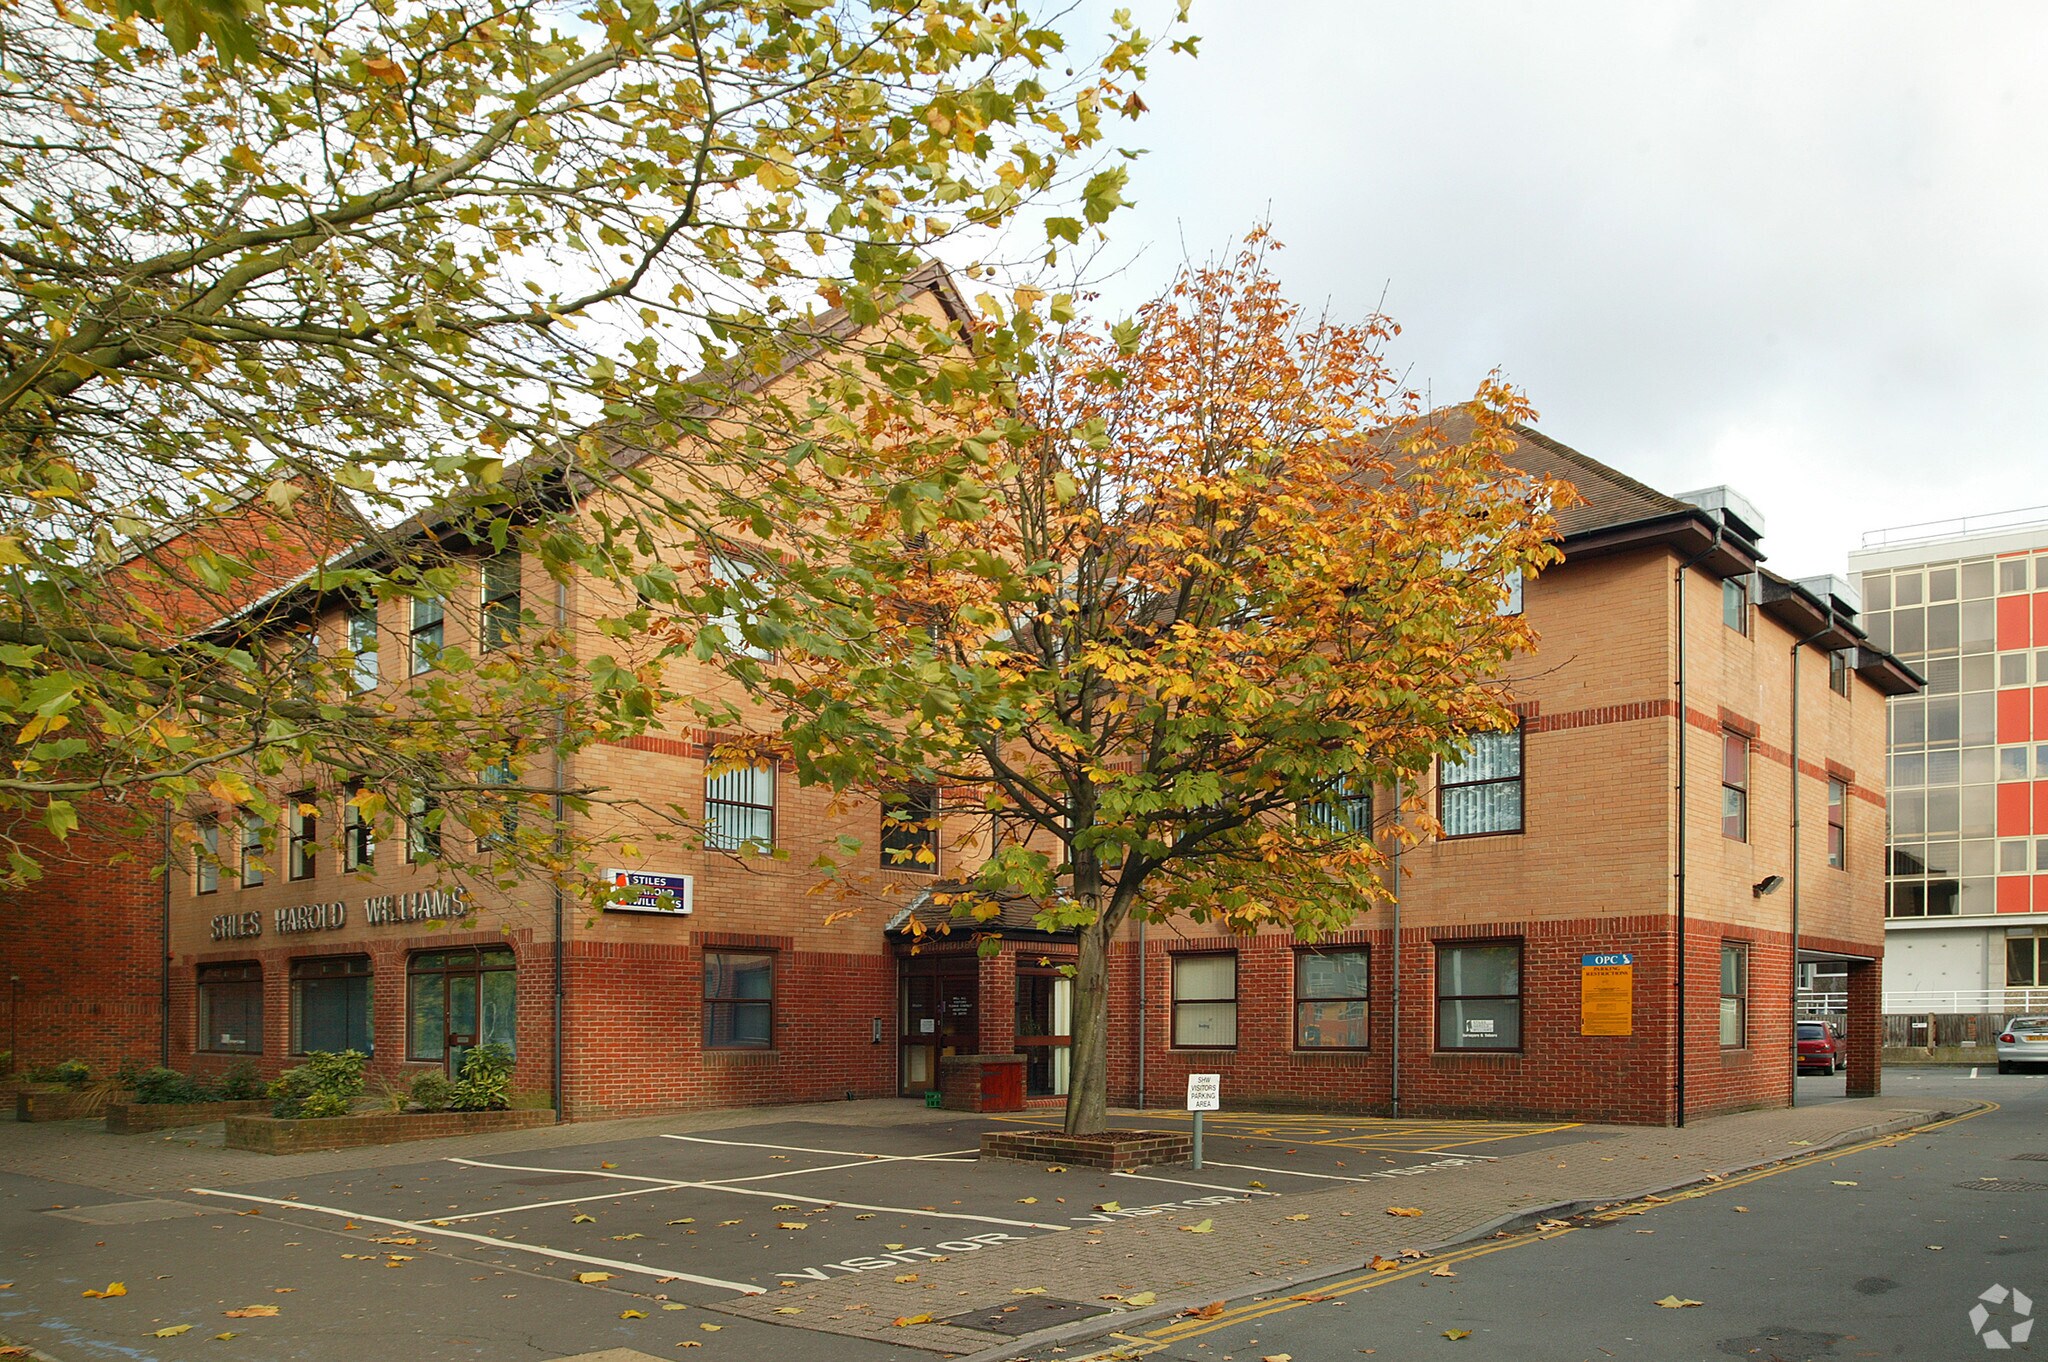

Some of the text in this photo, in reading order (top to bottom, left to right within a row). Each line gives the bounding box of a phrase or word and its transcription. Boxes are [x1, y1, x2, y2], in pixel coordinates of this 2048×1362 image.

[632, 876, 667, 886] STILES
[210, 886, 470, 941] STILES HAROLD WILLIAMS
[1595, 955, 1619, 965] OPC
[1070, 1195, 1252, 1222] VISITOR
[774, 1233, 1028, 1281] VISITOR
